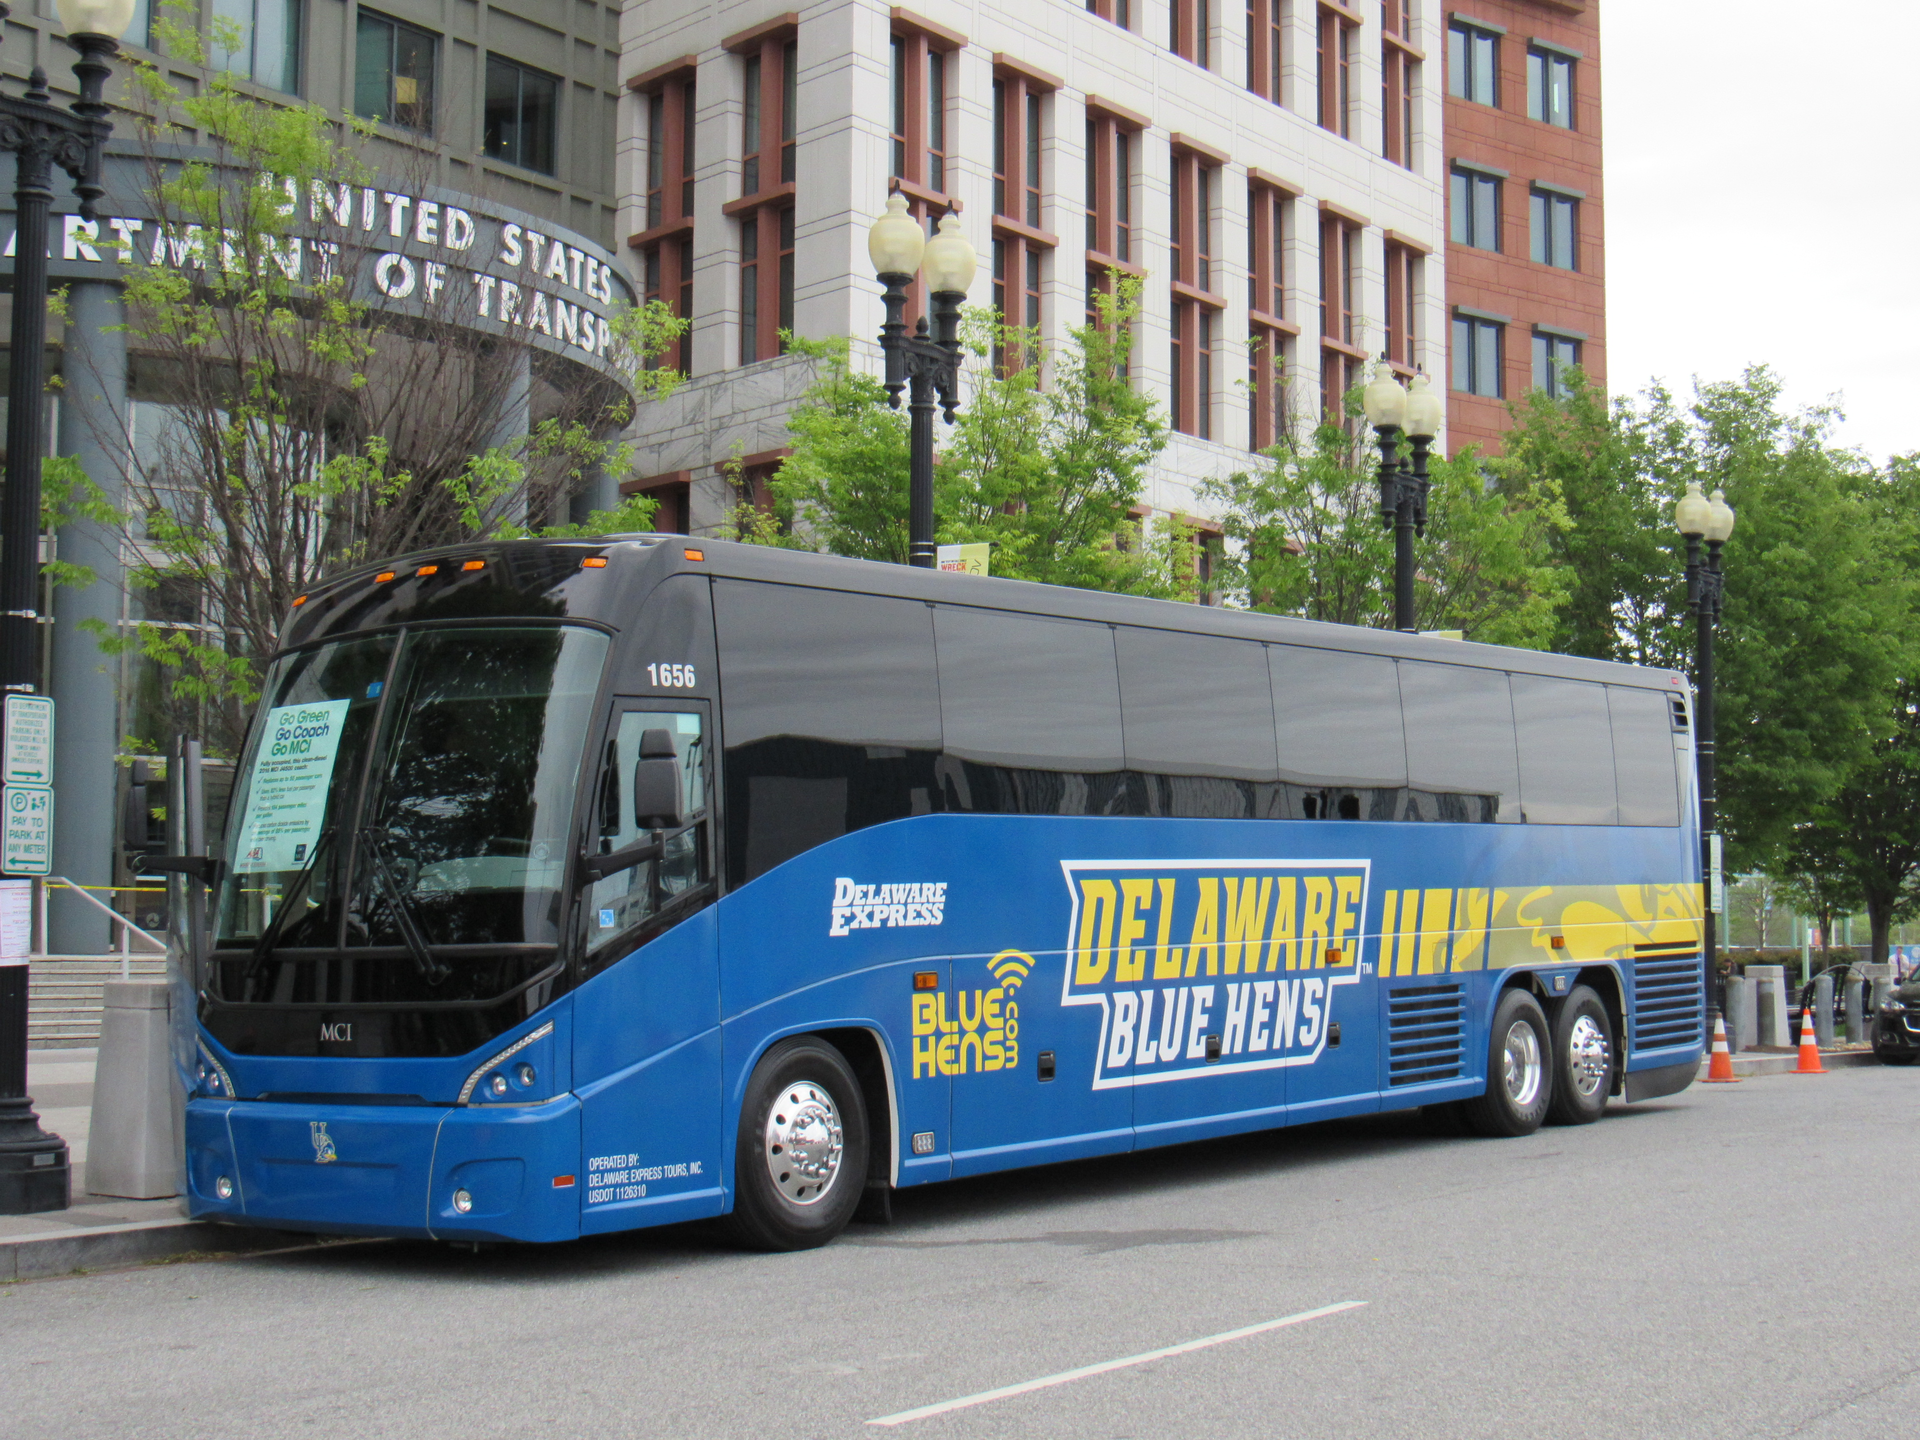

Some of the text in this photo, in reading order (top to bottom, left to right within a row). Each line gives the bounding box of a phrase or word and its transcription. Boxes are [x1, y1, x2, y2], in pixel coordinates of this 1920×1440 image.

[500, 223, 612, 306] STATES
[375, 253, 446, 304] OF
[941, 563, 967, 572] WRECK
[647, 662, 696, 688] 1656
[280, 710, 330, 726] Go Green
[276, 722, 329, 741] Go Coach
[271, 739, 312, 756] Go MCI
[12, 816, 43, 828] PAY TO
[9, 829, 46, 840] PARK AT
[8, 843, 46, 854] ANY METER
[832, 877, 948, 907] DELAWARE
[829, 902, 945, 937] EXPRESS
[1075, 875, 1362, 985] DELAWARE
[912, 988, 1004, 1036] BLUE
[1107, 977, 1324, 1069] BLUE HENS
[320, 1022, 353, 1041] MCI
[912, 1029, 1006, 1079] HENS
[589, 1153, 640, 1171] OPERATED BY:
[589, 1161, 703, 1187] DELAWARE EXPRESS TOURS, INC.
[589, 1184, 647, 1203] USDOT 1126310
